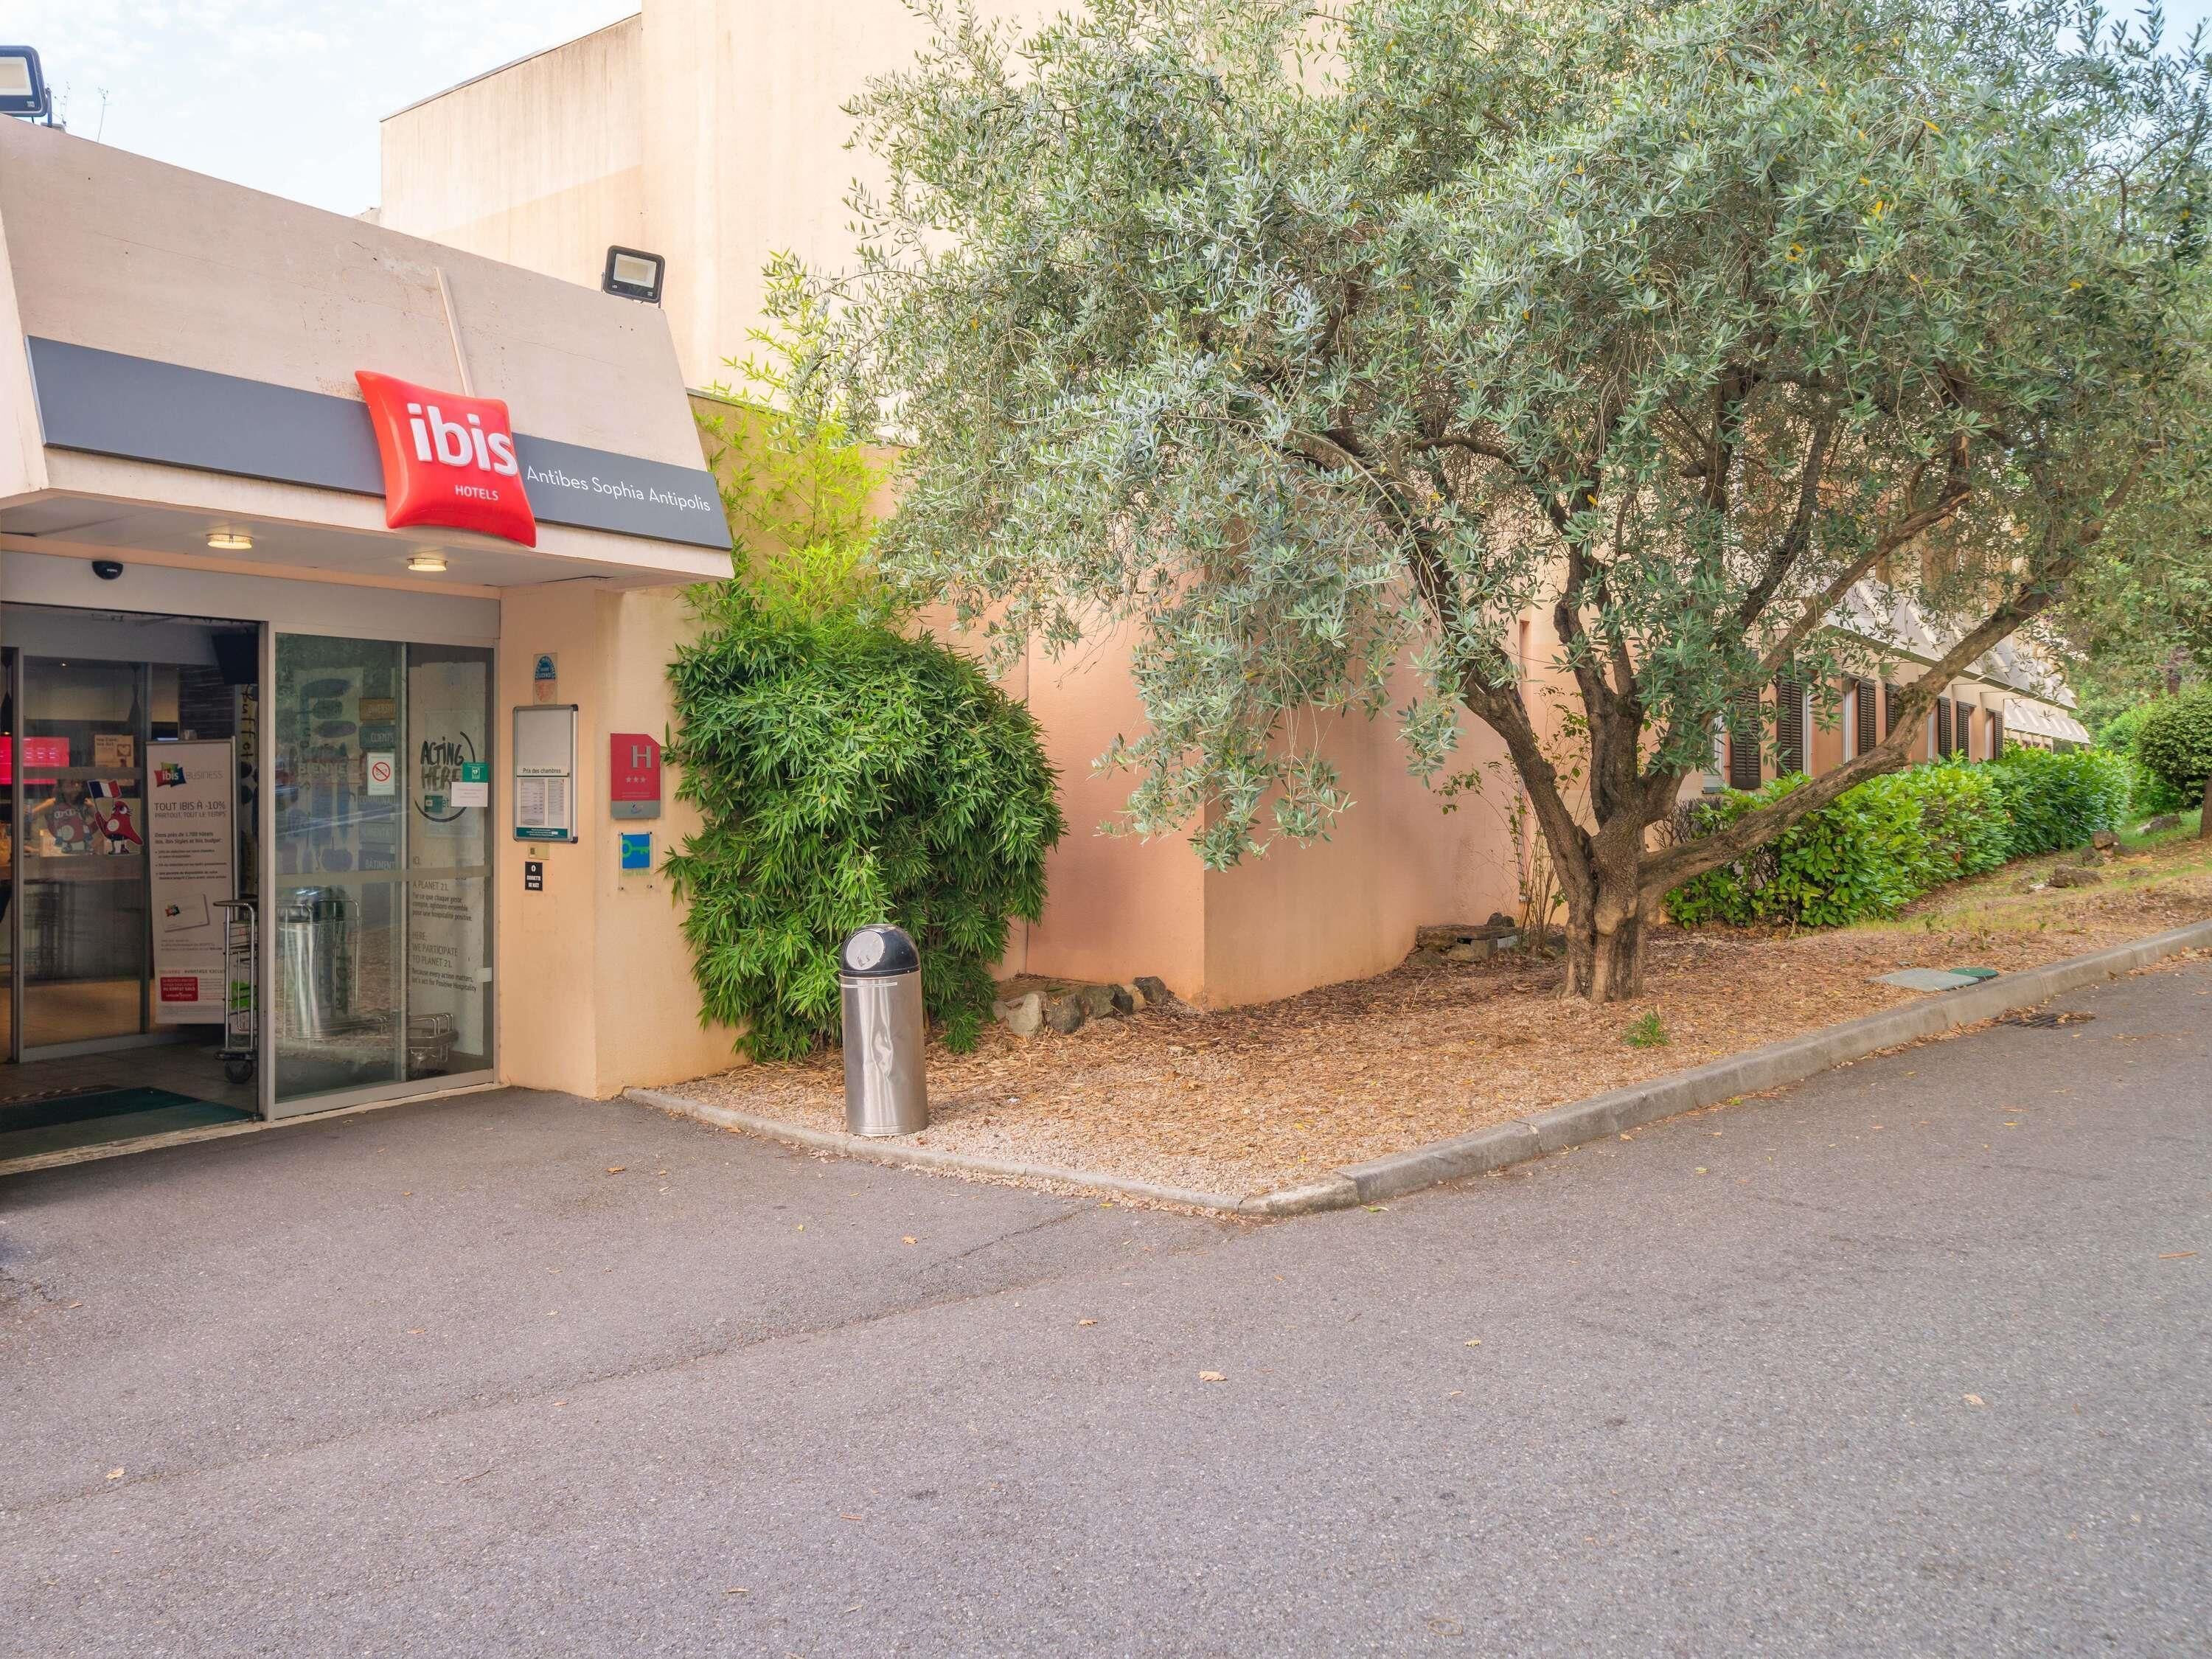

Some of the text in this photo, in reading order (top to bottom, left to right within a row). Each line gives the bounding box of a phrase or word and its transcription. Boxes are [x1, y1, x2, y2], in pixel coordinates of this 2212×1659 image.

[408, 403, 518, 478] ibis
[454, 484, 499, 501] HOTELS
[526, 466, 712, 512] Antibes Sophia Antipolis
[631, 745, 652, 768] H
[162, 771, 179, 781] ibis
[154, 802, 178, 811] TOUT
[179, 801, 194, 810] IBIS
[205, 801, 226, 810] -10%
[418, 880, 439, 891] PLANET
[412, 943, 459, 956] WE PARTICIPATE
[412, 955, 421, 963] TO
[422, 956, 442, 967] PLANET
